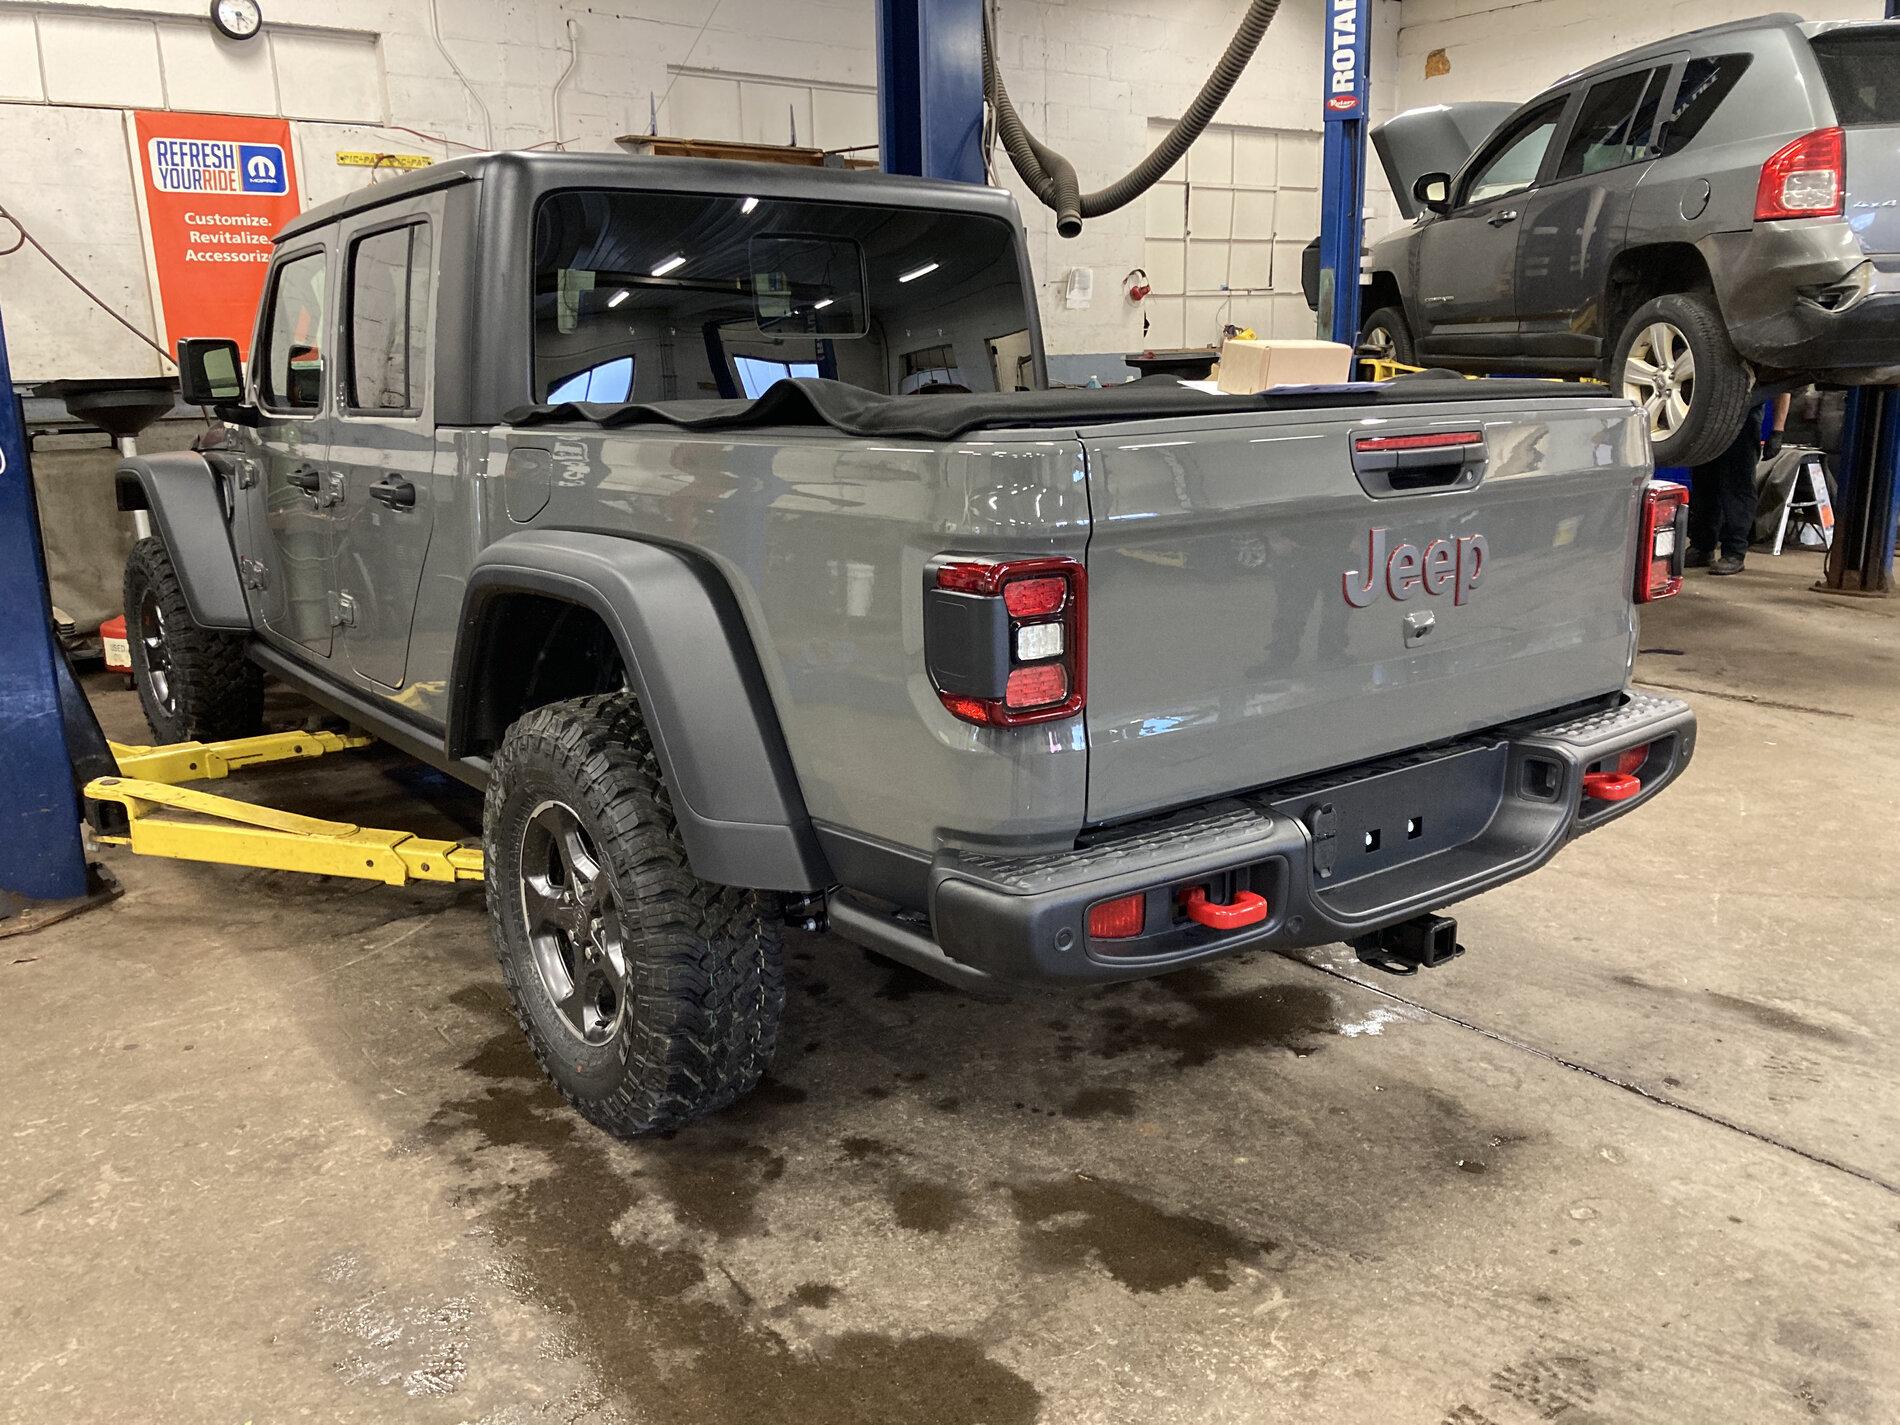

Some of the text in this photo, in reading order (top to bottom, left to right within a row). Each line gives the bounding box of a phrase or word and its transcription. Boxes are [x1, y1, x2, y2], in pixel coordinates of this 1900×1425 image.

[1330, 98, 1356, 107] Rotary
[156, 140, 235, 169] REFRESH
[184, 212, 272, 227] Customize.
[189, 230, 271, 245] Revitalize.
[185, 249, 271, 263] Accessoriz
[1342, 527, 1490, 608] Jeep
